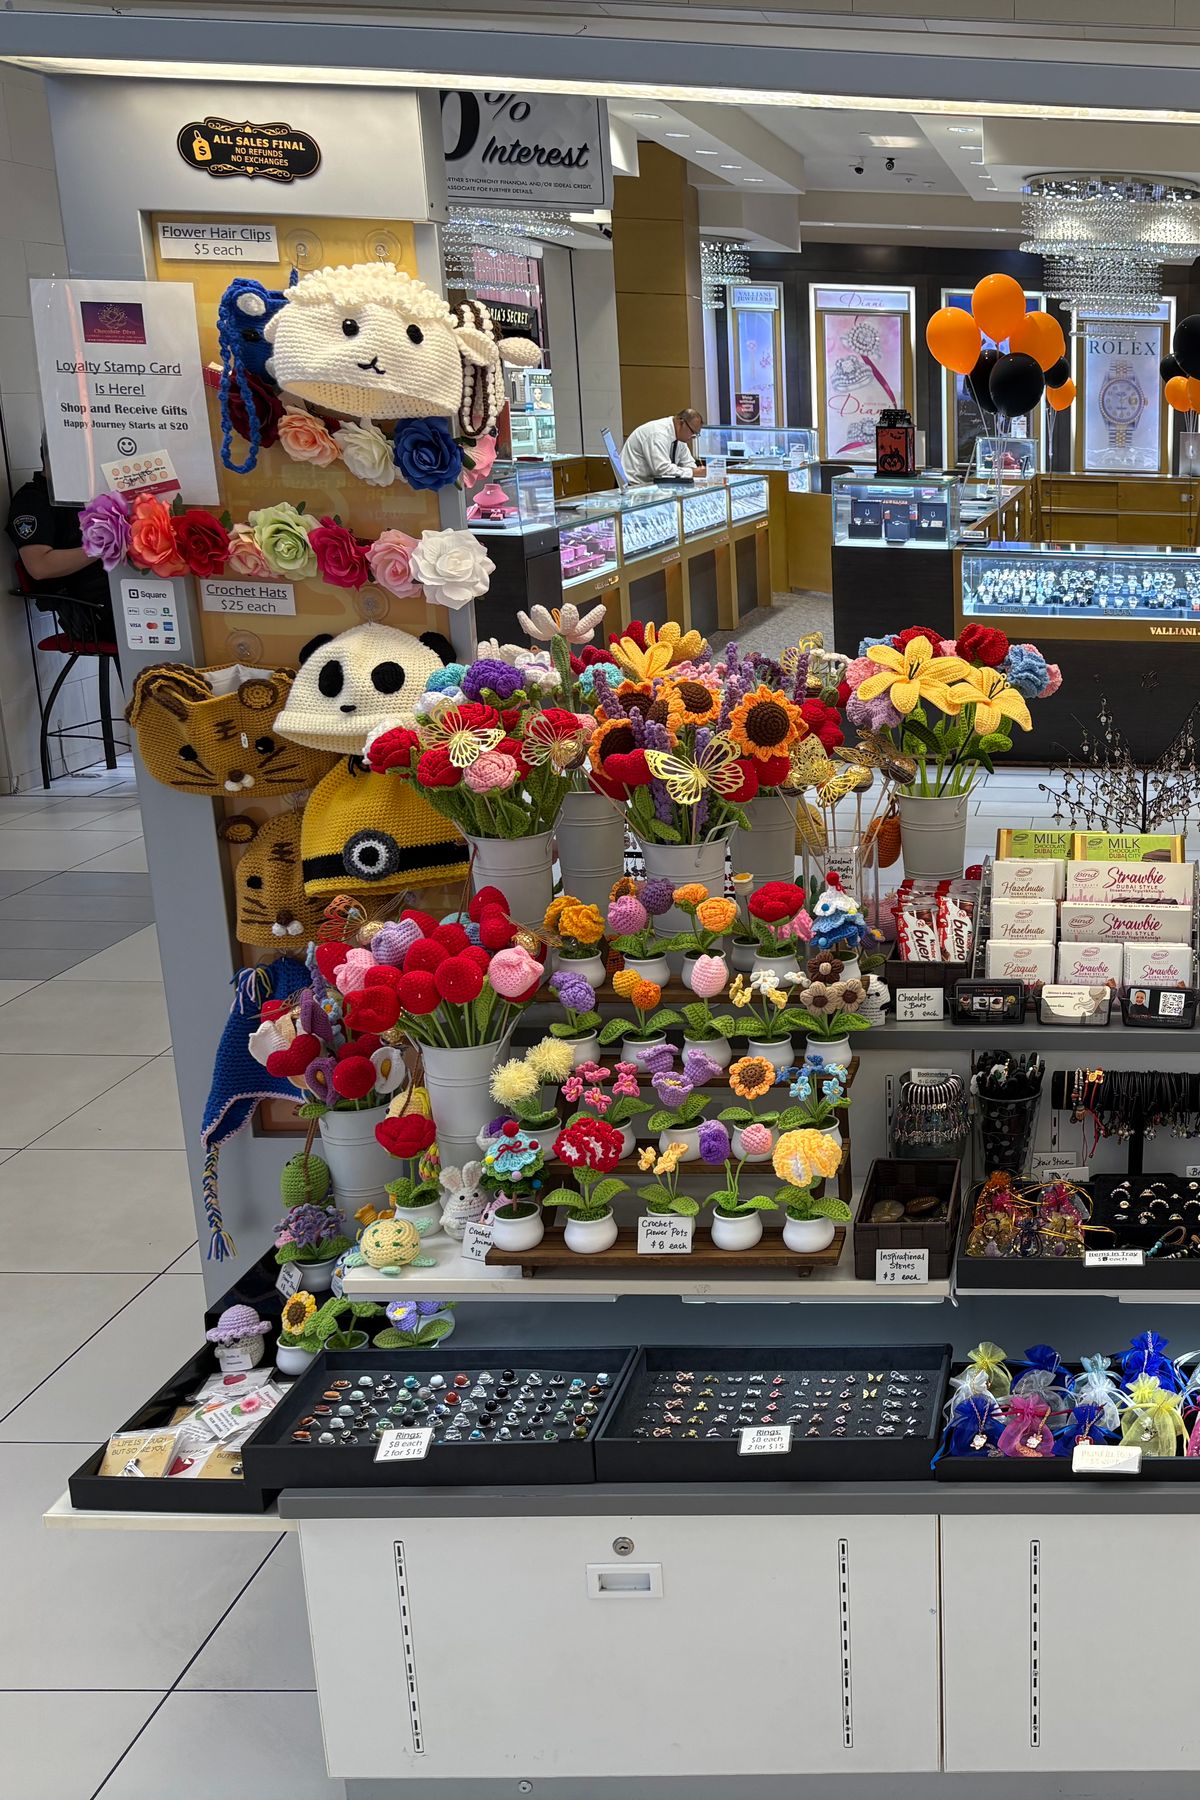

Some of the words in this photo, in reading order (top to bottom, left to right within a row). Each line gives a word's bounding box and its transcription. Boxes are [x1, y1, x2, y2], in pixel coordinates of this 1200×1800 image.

[213, 134, 233, 145] ALL
[236, 138, 269, 148] SALES
[272, 140, 306, 151] FINAL
[235, 147, 247, 155] NO
[249, 149, 283, 158] REFUNDS
[482, 136, 590, 169] Interest
[231, 155, 243, 163] NO
[245, 156, 289, 166] EXCHANGES
[162, 225, 206, 239] Flower
[210, 227, 237, 240] Hair
[240, 228, 272, 243] Clips
[194, 243, 210, 256] $5
[213, 244, 243, 256] each
[507, 309, 529, 325] SECRET
[1089, 340, 1156, 356] ROLEX
[56, 360, 100, 374] Loyalty
[104, 361, 146, 376] Stamp
[150, 362, 181, 375] Card
[95, 383, 105, 394] Is
[109, 383, 145, 395] Here!
[60, 402, 87, 415] Shop
[90, 403, 111, 414] and
[115, 404, 158, 415] Receive
[161, 405, 188, 416] Gifts
[64, 418, 89, 430] Happy
[91, 420, 127, 431] Journey
[128, 420, 156, 430] Starts
[158, 421, 168, 430] at
[169, 421, 189, 431] $20
[140, 590, 167, 600] Square
[206, 584, 255, 597] Crochet
[259, 586, 287, 599] Hats
[221, 600, 243, 611] $25
[247, 601, 276, 613] each
[1000, 606, 1029, 614] BULOVA
[1103, 609, 1133, 617] BULOVA
[1150, 626, 1197, 636] VALLIANI
[1034, 833, 1067, 844] MILK
[1108, 838, 1141, 849] MILK
[1102, 866, 1166, 888] Strawbie
[1098, 913, 1163, 935] Strawbie
[953, 918, 969, 961] bueno
[1071, 960, 1110, 976] Strawbie
[1140, 964, 1180, 979] Strawbie
[898, 993, 934, 1002] Chocolate
[642, 1219, 673, 1229] Crochet
[468, 1228, 492, 1239] Crochet
[645, 1228, 668, 1239] Flower
[671, 1228, 688, 1238] Pots
[651, 1240, 665, 1250] $8
[470, 1247, 482, 1257] $12
[880, 1250, 925, 1264] Inspirational
[889, 1261, 915, 1270] Stones
[396, 1432, 423, 1440] Rings:
[116, 1439, 133, 1447] LIFE
[401, 1440, 423, 1448] each
[111, 1448, 127, 1456] BUT
[128, 1447, 140, 1455] SO
[391, 1449, 404, 1457] for
[405, 1448, 422, 1456] $15
